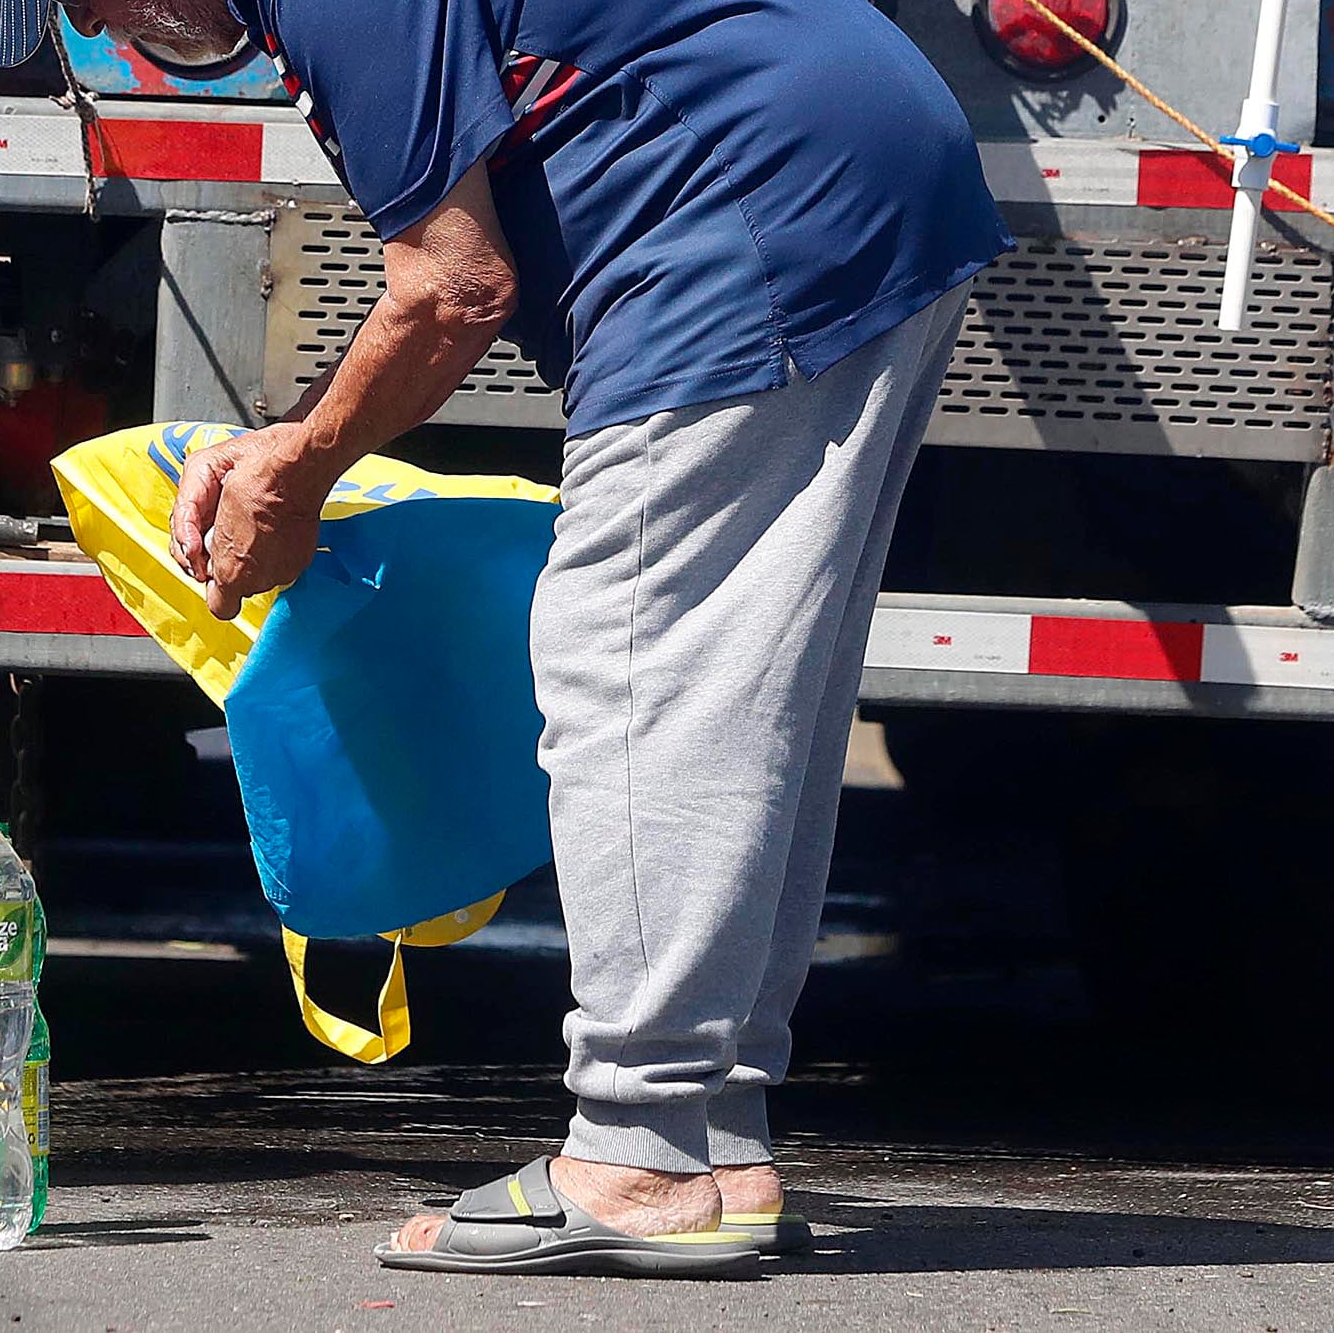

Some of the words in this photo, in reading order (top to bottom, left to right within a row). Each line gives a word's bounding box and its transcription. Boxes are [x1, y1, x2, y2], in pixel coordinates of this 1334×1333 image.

[1041, 168, 1061, 180] 3M
[933, 635, 953, 647] 3M
[1279, 652, 1300, 664] 3M
